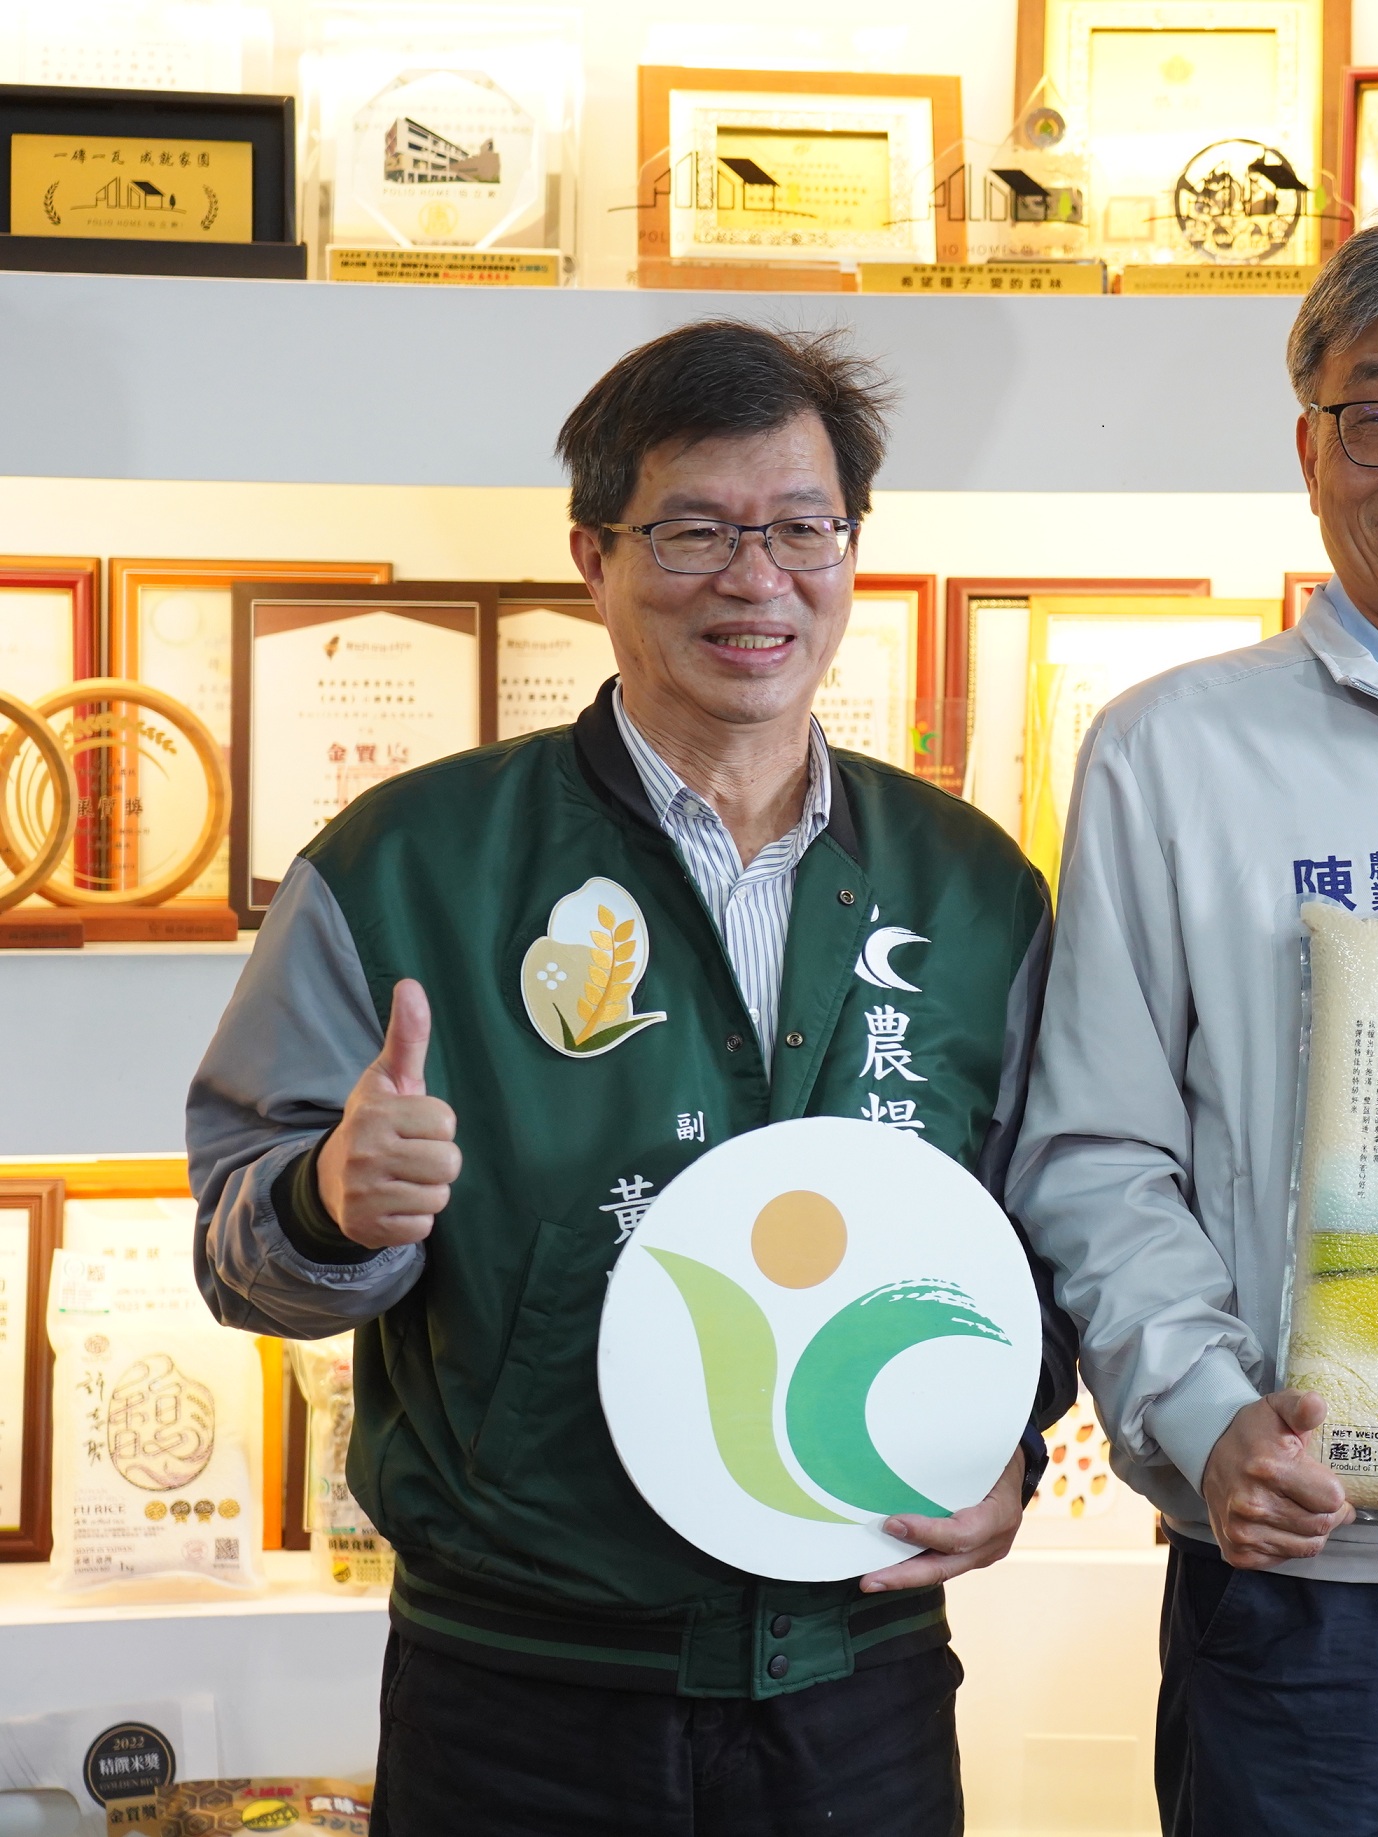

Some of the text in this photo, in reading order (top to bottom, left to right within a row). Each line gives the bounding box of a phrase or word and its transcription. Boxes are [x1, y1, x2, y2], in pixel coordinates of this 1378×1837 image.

[1293, 855, 1357, 912] 陳
[676, 1111, 705, 1143] 副
[1331, 1429, 1353, 1439] NET
[1330, 1462, 1361, 1473] Product
[1363, 1463, 1372, 1473] of
[112, 1736, 146, 1752] 2022
